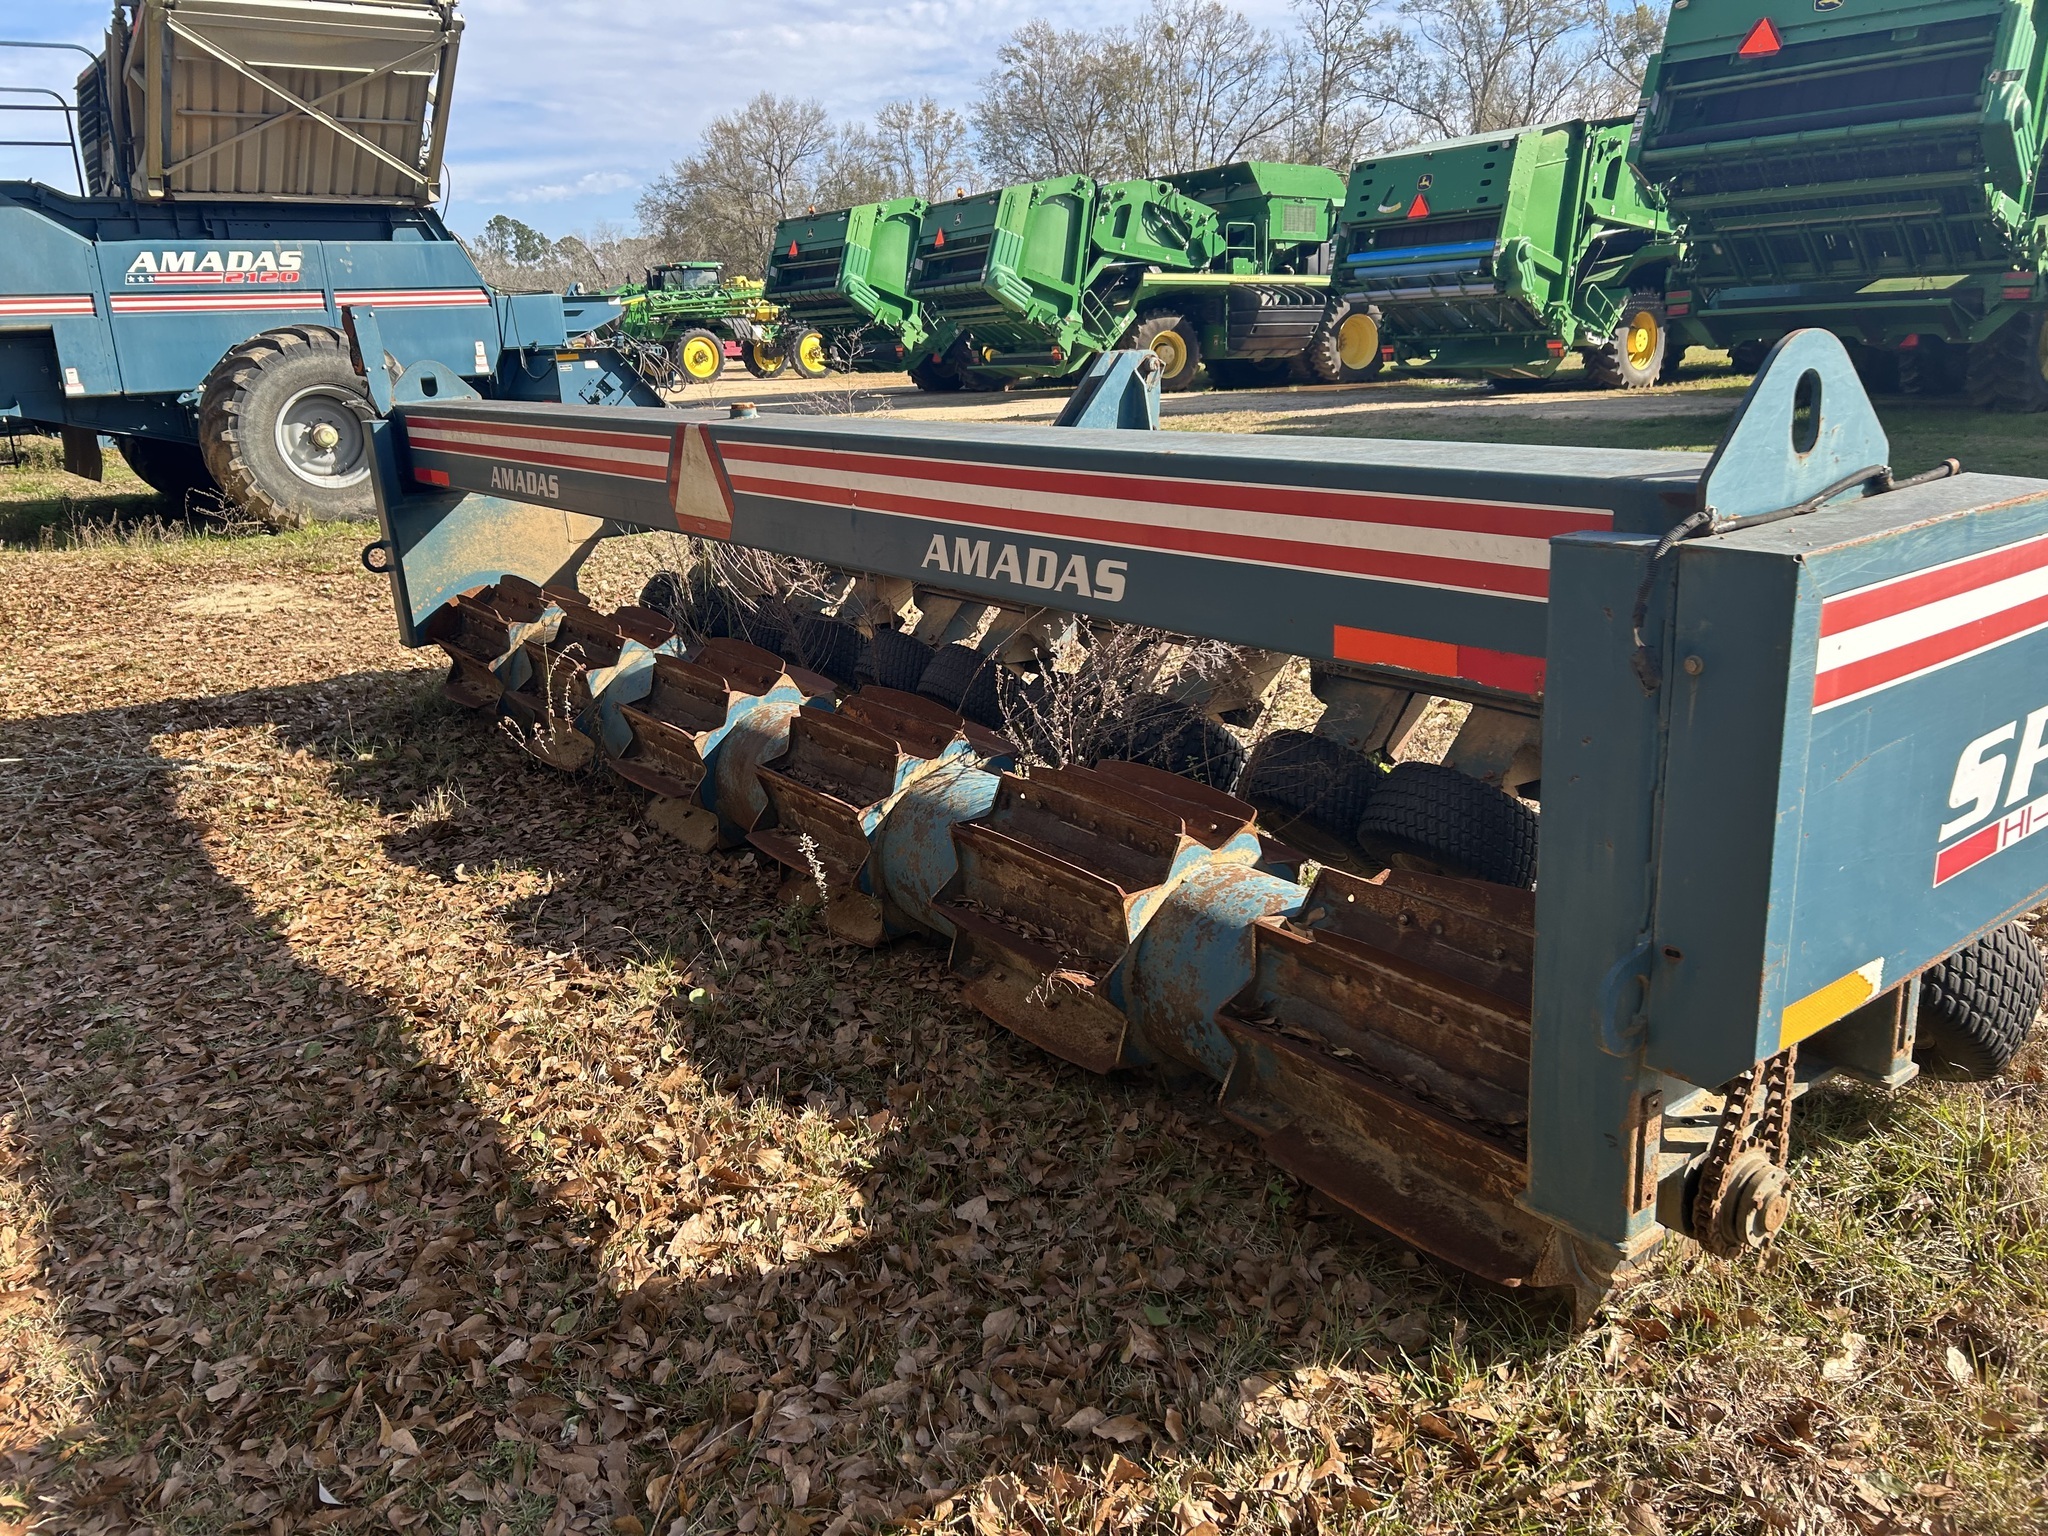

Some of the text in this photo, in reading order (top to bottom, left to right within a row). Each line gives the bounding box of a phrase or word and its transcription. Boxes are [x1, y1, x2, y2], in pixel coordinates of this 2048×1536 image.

[127, 251, 302, 273] AMADAS
[223, 271, 300, 284] 2120
[490, 466, 560, 499] AMADAS
[920, 533, 1128, 602] AMADAS
